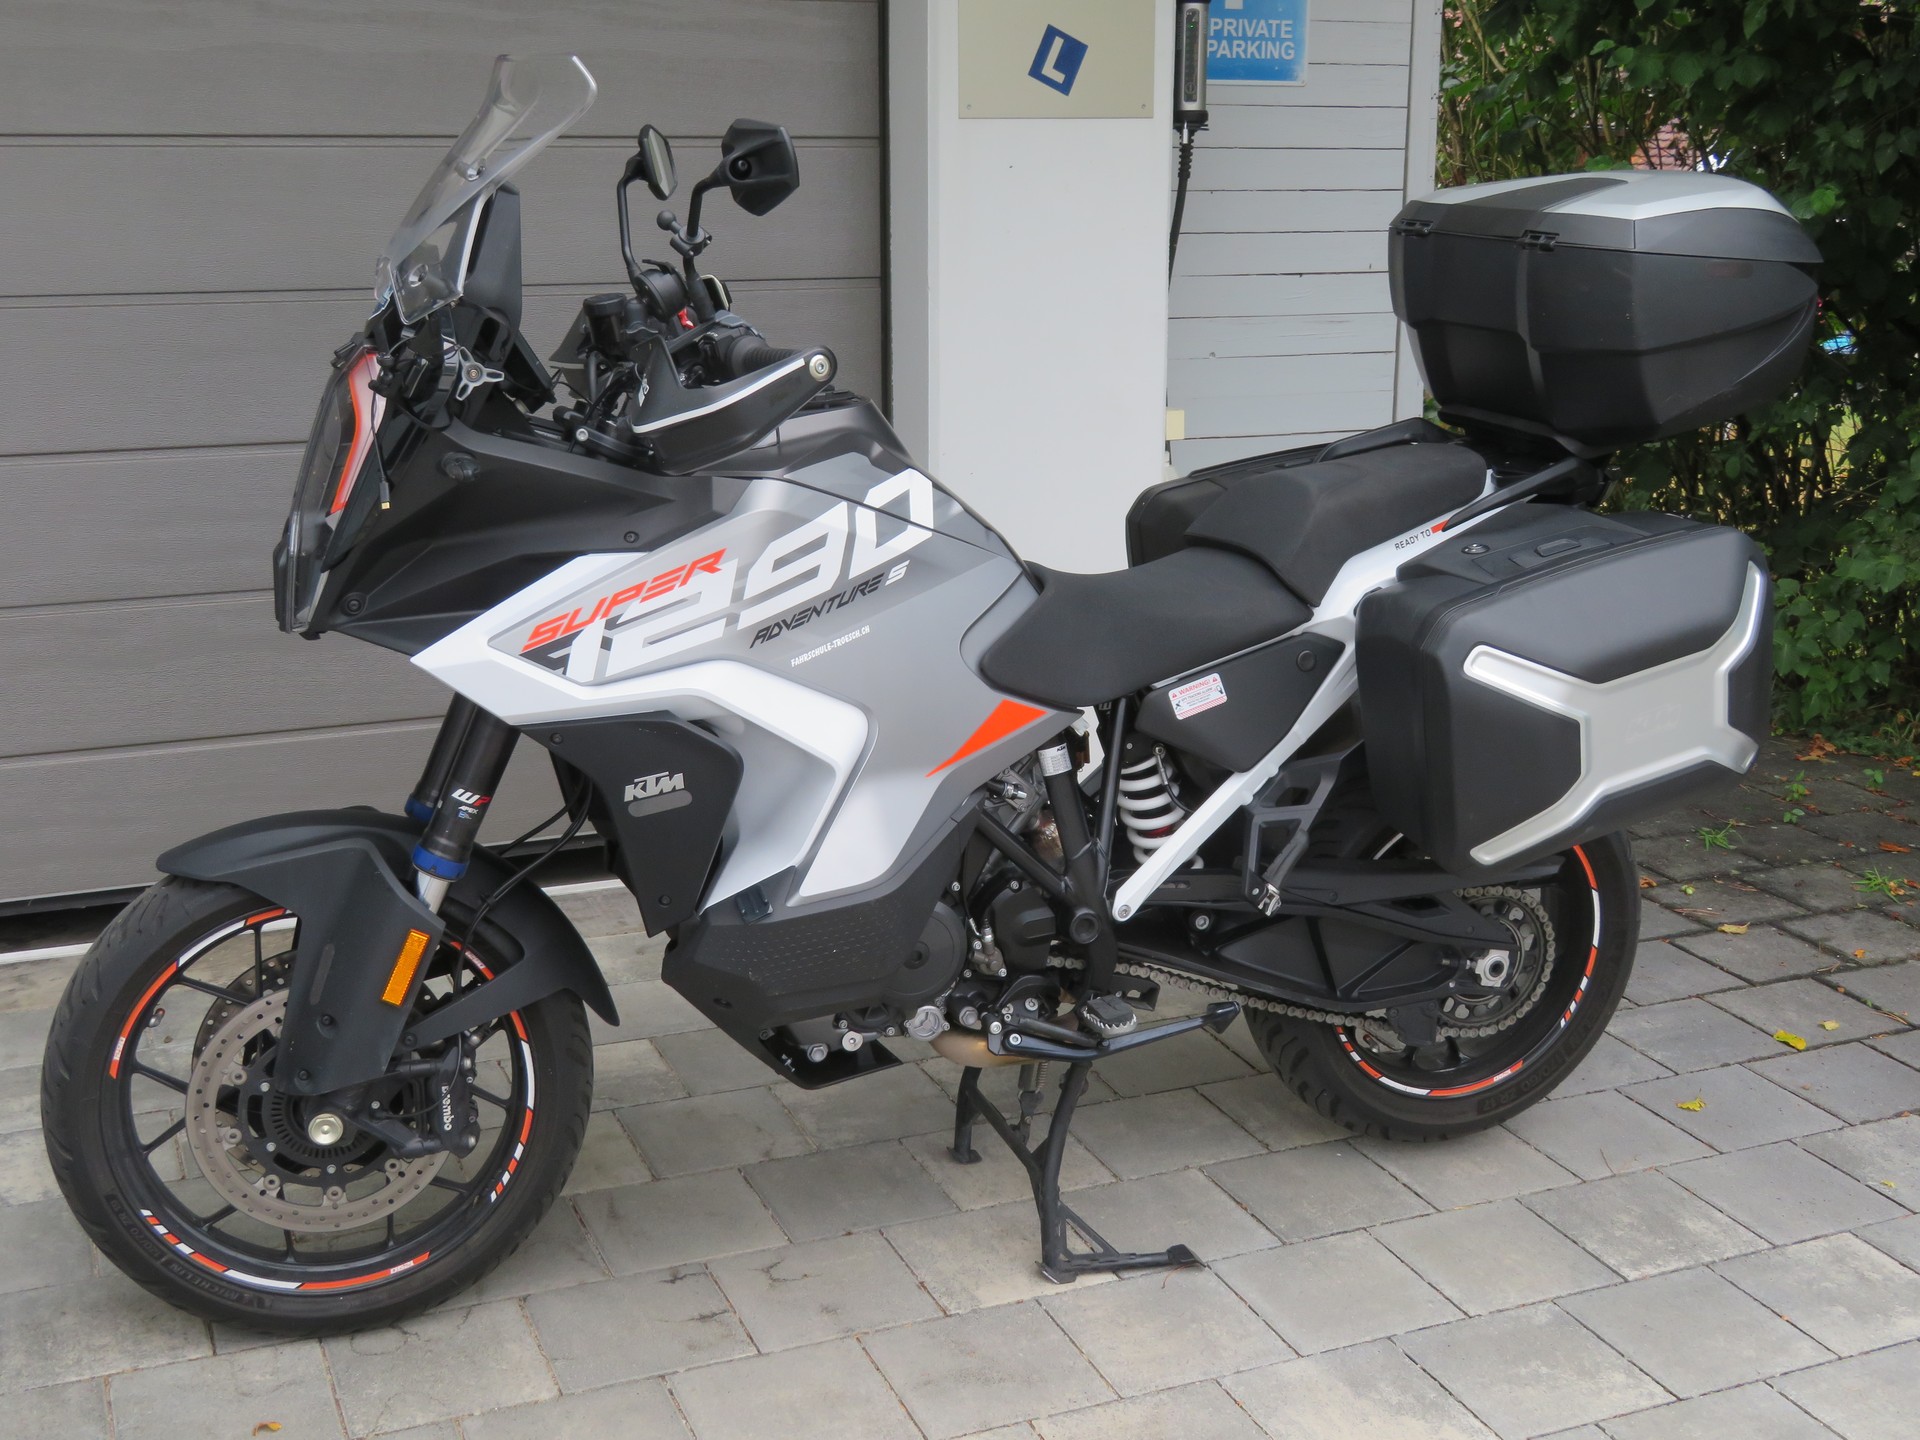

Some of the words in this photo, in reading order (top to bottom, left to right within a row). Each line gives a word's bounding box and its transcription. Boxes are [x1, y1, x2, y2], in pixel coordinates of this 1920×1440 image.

[1210, 18, 1293, 39] PRIVATE
[1041, 35, 1066, 84] L
[1206, 39, 1295, 60] PARKING
[1394, 534, 1419, 551] READY
[1420, 529, 1431, 539] TO
[566, 468, 933, 683] 1290
[521, 547, 727, 652] SUPER
[750, 573, 885, 649] ADVENTURE
[885, 560, 910, 586] S
[790, 624, 870, 667] FAHRSCHULE-TROESCH.CH
[1178, 679, 1211, 695] WARNING!
[451, 788, 492, 807] WP
[624, 771, 685, 802] KTM
[458, 805, 479, 815] APEX
[168, 1262, 240, 1301] MICHELIN
